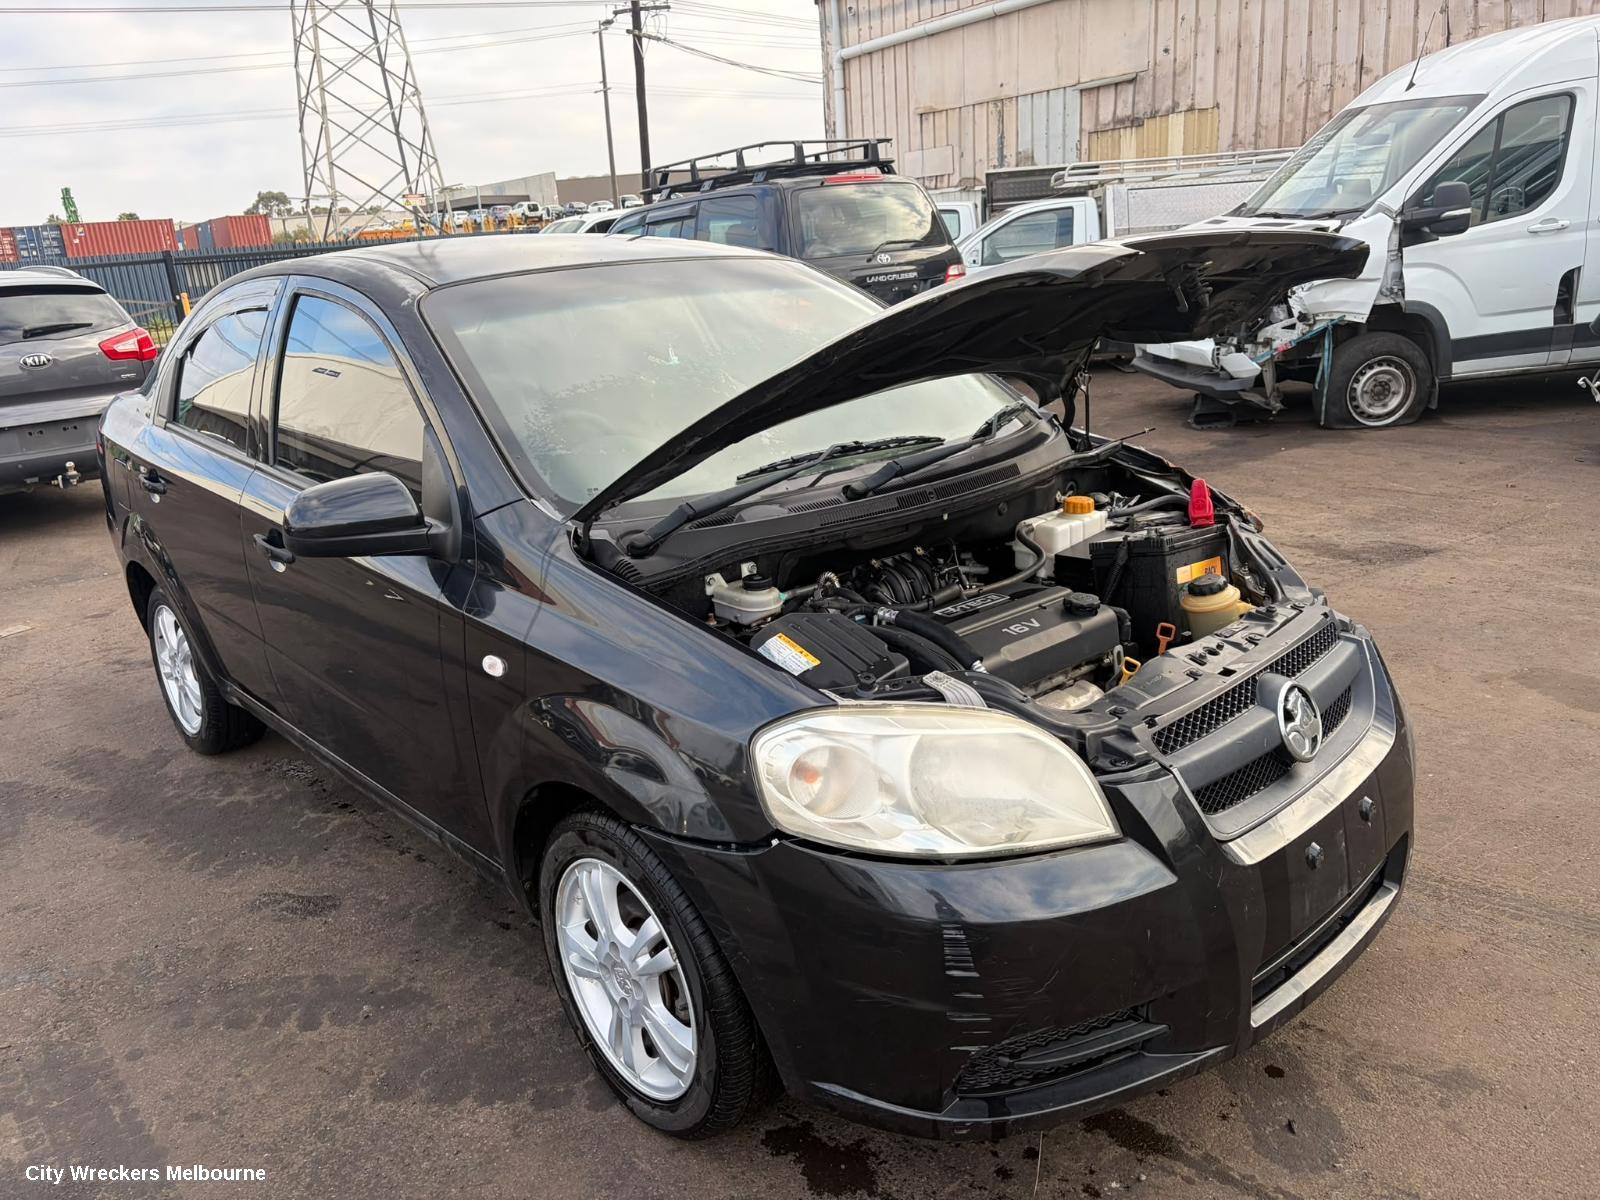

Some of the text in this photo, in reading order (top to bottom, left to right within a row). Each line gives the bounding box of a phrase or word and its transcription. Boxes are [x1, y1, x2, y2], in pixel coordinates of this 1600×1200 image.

[866, 272, 918, 283] LAND CRUISER
[25, 356, 49, 366] KIA
[1001, 618, 1041, 635] 16V
